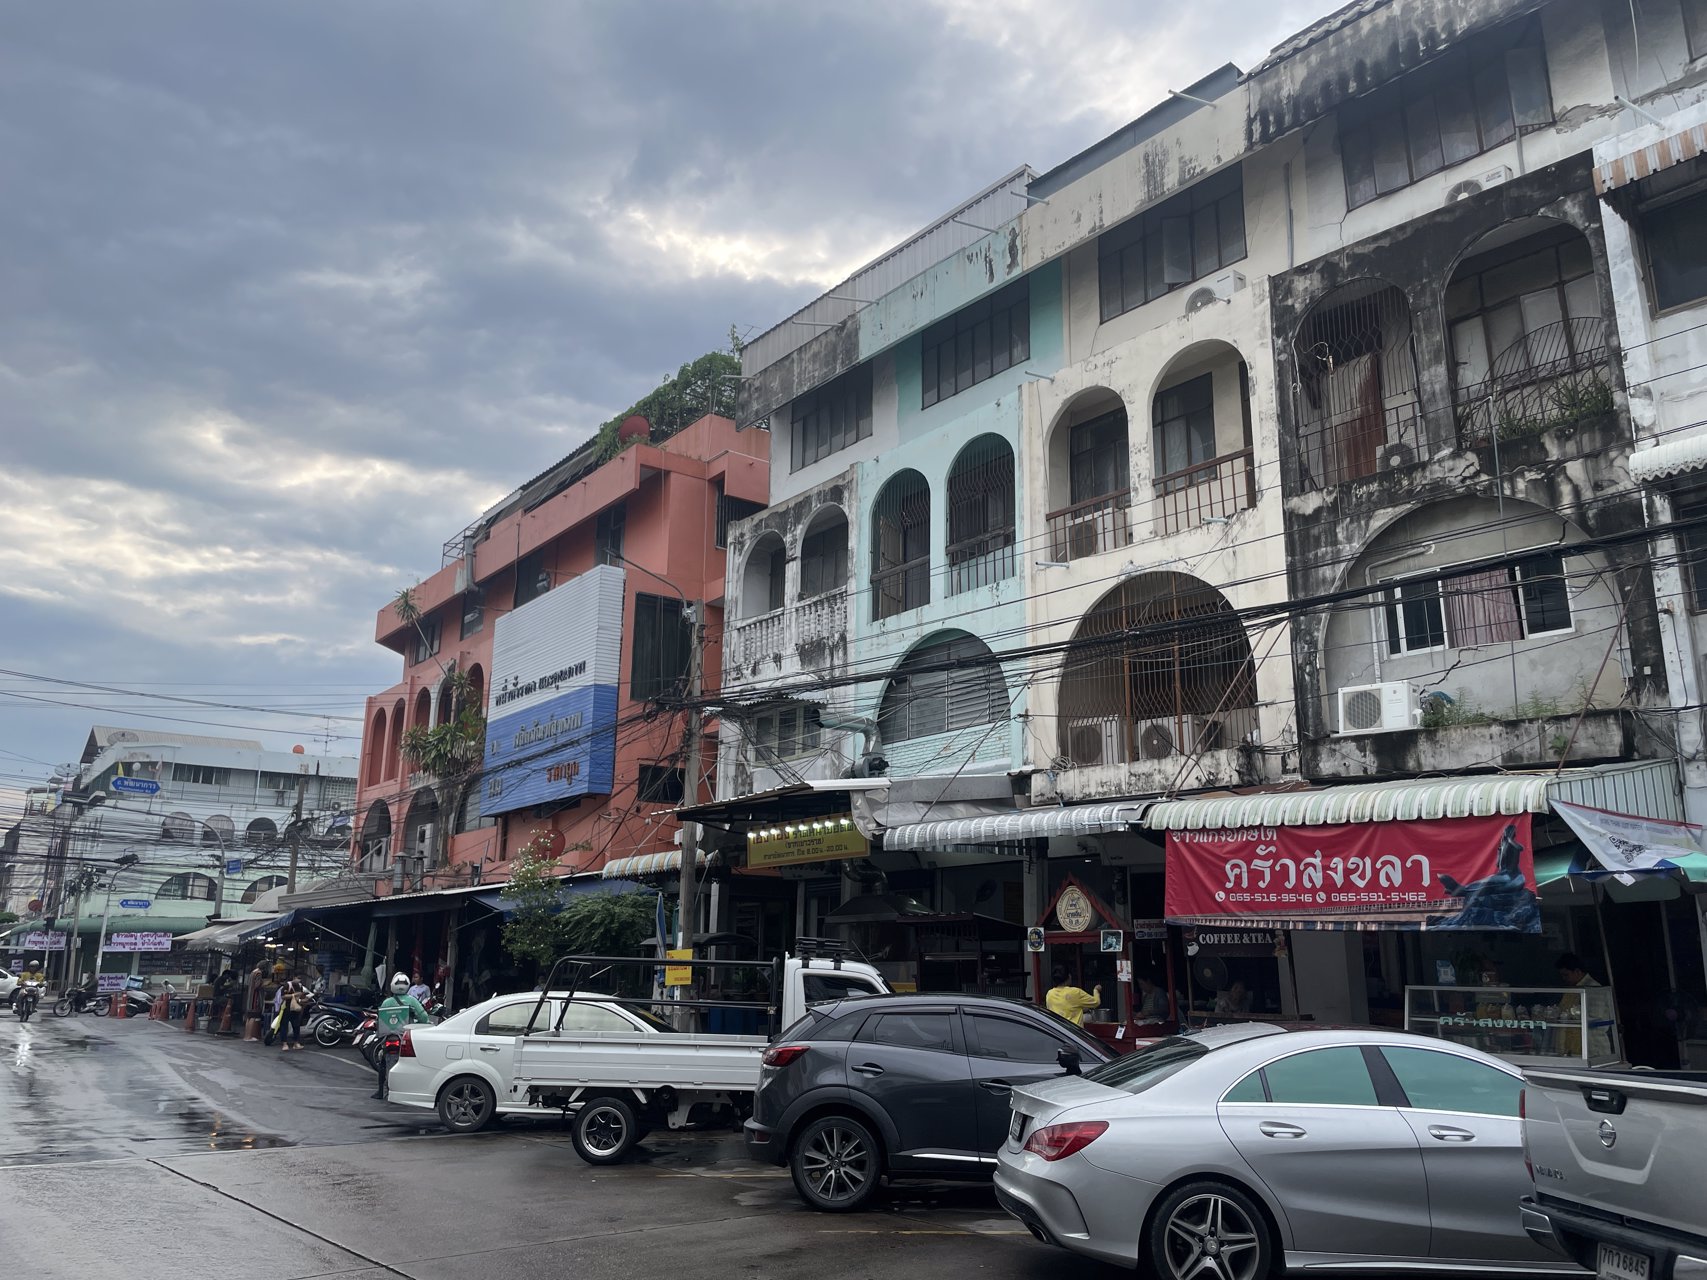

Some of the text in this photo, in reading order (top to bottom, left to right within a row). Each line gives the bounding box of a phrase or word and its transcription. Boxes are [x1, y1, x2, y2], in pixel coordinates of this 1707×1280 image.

[1225, 845, 1431, 889] ครัวสงขลา
[1229, 892, 1426, 902] 065-516-9546 065-591-5462
[1199, 933, 1240, 945] COFFEE
